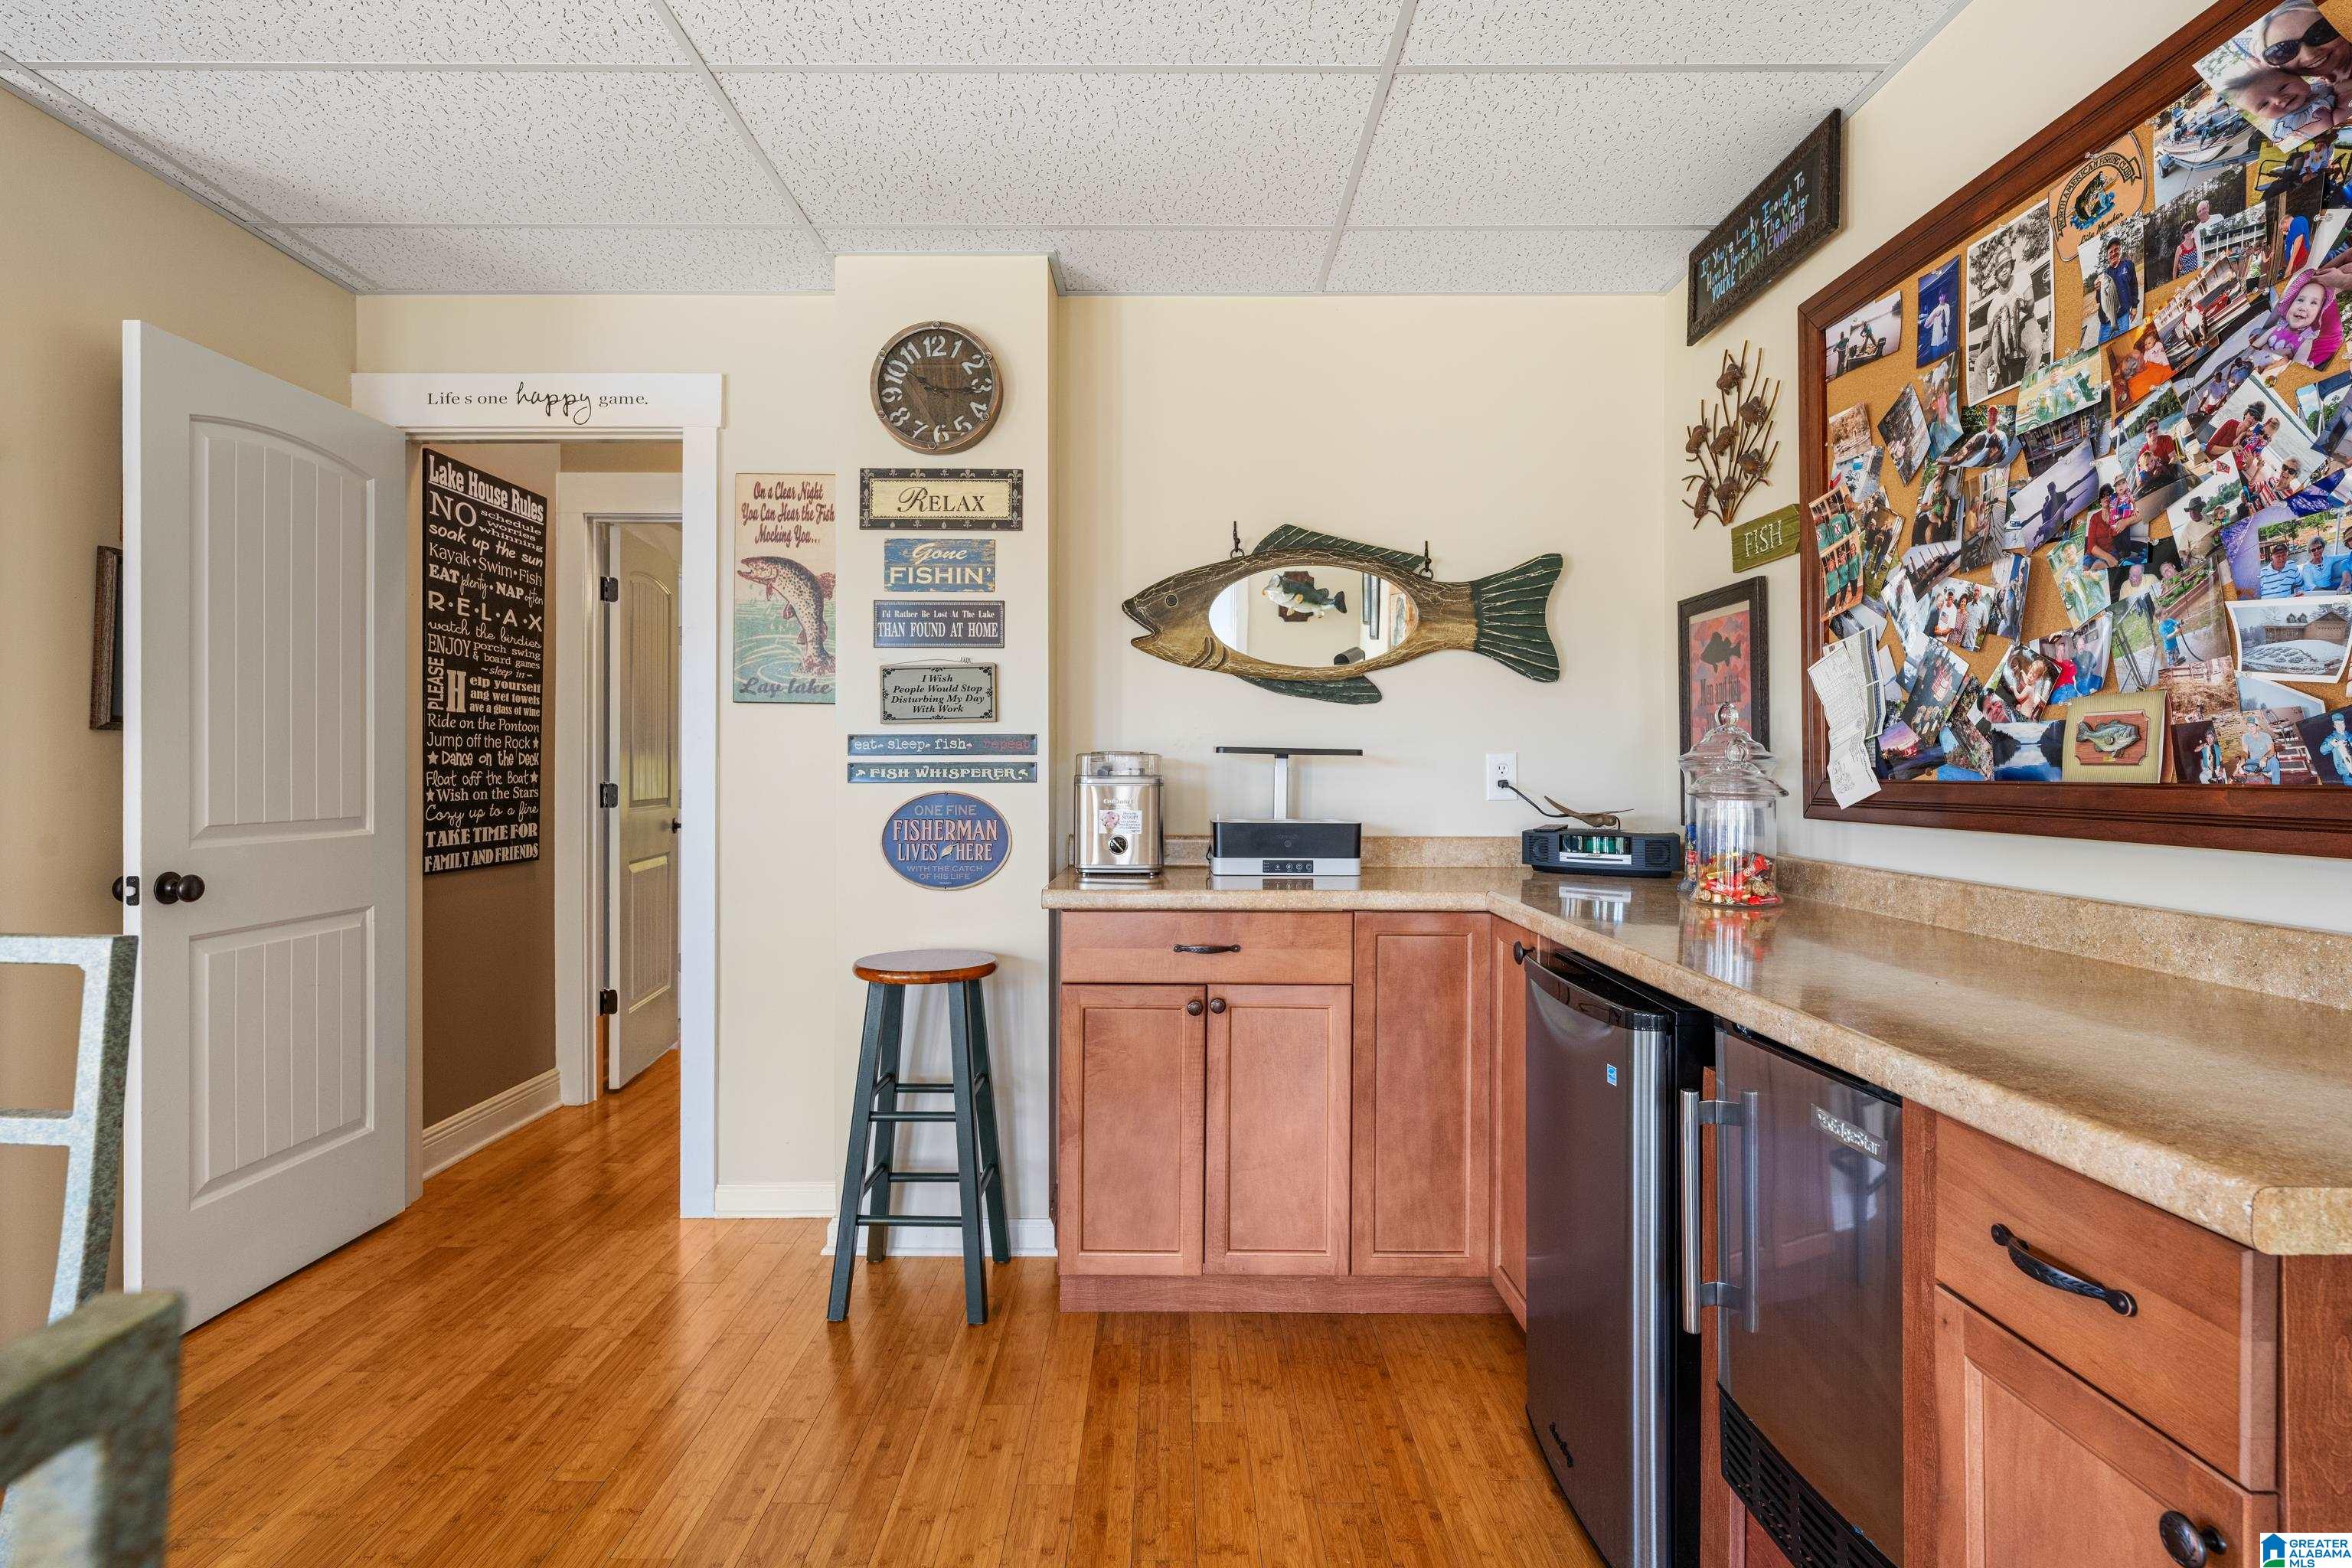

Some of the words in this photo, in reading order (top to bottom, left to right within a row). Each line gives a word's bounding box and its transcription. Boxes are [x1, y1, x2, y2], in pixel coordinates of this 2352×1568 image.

[2118, 158, 2132, 179] CLUB
[1794, 171, 1805, 192] To
[1723, 257, 1729, 276] A
[1750, 234, 1760, 250] By
[1762, 218, 1781, 240] The
[900, 341, 921, 364] 11
[923, 335, 947, 358] 12
[950, 340, 962, 358] 1
[884, 359, 908, 384] 10
[962, 354, 985, 375] 2
[881, 387, 902, 403] 9
[971, 377, 992, 393] 3
[478, 394, 508, 405] one
[517, 381, 592, 425] happy
[599, 394, 648, 407] game.
[969, 402, 988, 418] 4
[890, 407, 910, 426] 8
[953, 416, 973, 436] 5
[913, 420, 929, 438] 7
[933, 424, 949, 443] 6
[430, 455, 464, 492] Lake
[469, 471, 508, 508] House
[511, 488, 544, 522] Rules
[754, 482, 766, 500] On
[775, 482, 795, 500] Clear
[798, 482, 823, 505] Night
[897, 486, 985, 513] RELAX
[430, 491, 477, 527] NO
[481, 510, 541, 535] schedule
[742, 502, 759, 526] You
[760, 503, 776, 521] Can
[778, 502, 800, 522] Hear
[802, 505, 815, 521] the
[816, 503, 835, 524] Fish
[487, 521, 536, 541] worries
[755, 524, 792, 547] Mocking
[1744, 520, 1782, 557] FISH
[430, 524, 466, 544] soak
[472, 538, 489, 556] up
[496, 541, 516, 558] the
[521, 554, 543, 567] sun
[912, 543, 967, 565] Gone
[430, 542, 471, 567] Kayak
[479, 557, 512, 578] Swim
[519, 569, 542, 586] Fish
[890, 567, 991, 584] FISHIN'
[430, 564, 459, 583] EAT
[461, 573, 488, 599] plenty
[496, 582, 524, 599] NAP
[524, 588, 543, 609] often
[428, 619, 470, 635] watch
[475, 622, 495, 640] the
[501, 627, 542, 648] birdies
[877, 622, 905, 637] THAN
[910, 622, 946, 637] FOUND
[950, 622, 964, 637] AT
[968, 622, 998, 637] HOME
[428, 633, 471, 658] ENJOY
[473, 642, 507, 654] porch
[511, 648, 541, 661] swing
[473, 652, 479, 661] &
[484, 653, 511, 665] board
[515, 659, 541, 669] games
[489, 666, 512, 679] sleep
[929, 674, 953, 682] Wish
[427, 656, 444, 710] PLEASE
[494, 680, 541, 693] yourself
[893, 685, 925, 694] People
[928, 684, 958, 693] Would
[961, 684, 982, 693] Stop
[492, 692, 509, 701] wet
[511, 693, 540, 705] towels
[891, 695, 944, 704] Disturbing
[947, 695, 962, 704] My
[965, 694, 985, 704] Day
[486, 704, 492, 713] a
[494, 704, 512, 715] glass
[514, 705, 521, 716] of
[524, 707, 541, 717] wine
[913, 705, 935, 714] With
[427, 714, 456, 728] Ride
[459, 720, 475, 729] on
[478, 716, 495, 730] the
[498, 719, 539, 733] Pontoon
[427, 732, 462, 750] Jump
[466, 734, 481, 747] off
[484, 733, 501, 748] the
[505, 736, 531, 749] Rock
[854, 740, 877, 750] eat
[887, 739, 925, 753] sleep
[935, 739, 966, 750] fish
[983, 740, 1030, 750] repeat
[442, 750, 474, 766] Dance
[479, 753, 492, 766] on
[498, 750, 514, 766] the
[519, 752, 539, 765] Deck
[426, 770, 457, 787] Float
[462, 771, 482, 786] off
[486, 771, 502, 785] the
[508, 770, 529, 785] Boat
[869, 768, 910, 779] FISH
[914, 766, 1022, 780] WHISPERER
[436, 789, 469, 802] Wish
[472, 790, 488, 800] on
[492, 788, 510, 799] the
[512, 786, 539, 799] Stars
[426, 805, 465, 828] Cozy
[469, 808, 485, 823] up
[490, 805, 503, 816] to
[518, 801, 539, 822] fire
[914, 805, 942, 815] ONE
[946, 805, 977, 815] FINE
[426, 828, 471, 848] TAKE
[473, 825, 508, 843] TIME
[511, 823, 537, 839] FOR
[893, 818, 998, 841] FISHERMAN
[425, 851, 469, 873] FAMILY
[471, 849, 494, 865] AND
[495, 843, 538, 862] FRIENDS
[897, 843, 938, 861] LIVES
[956, 843, 992, 861] HERE
